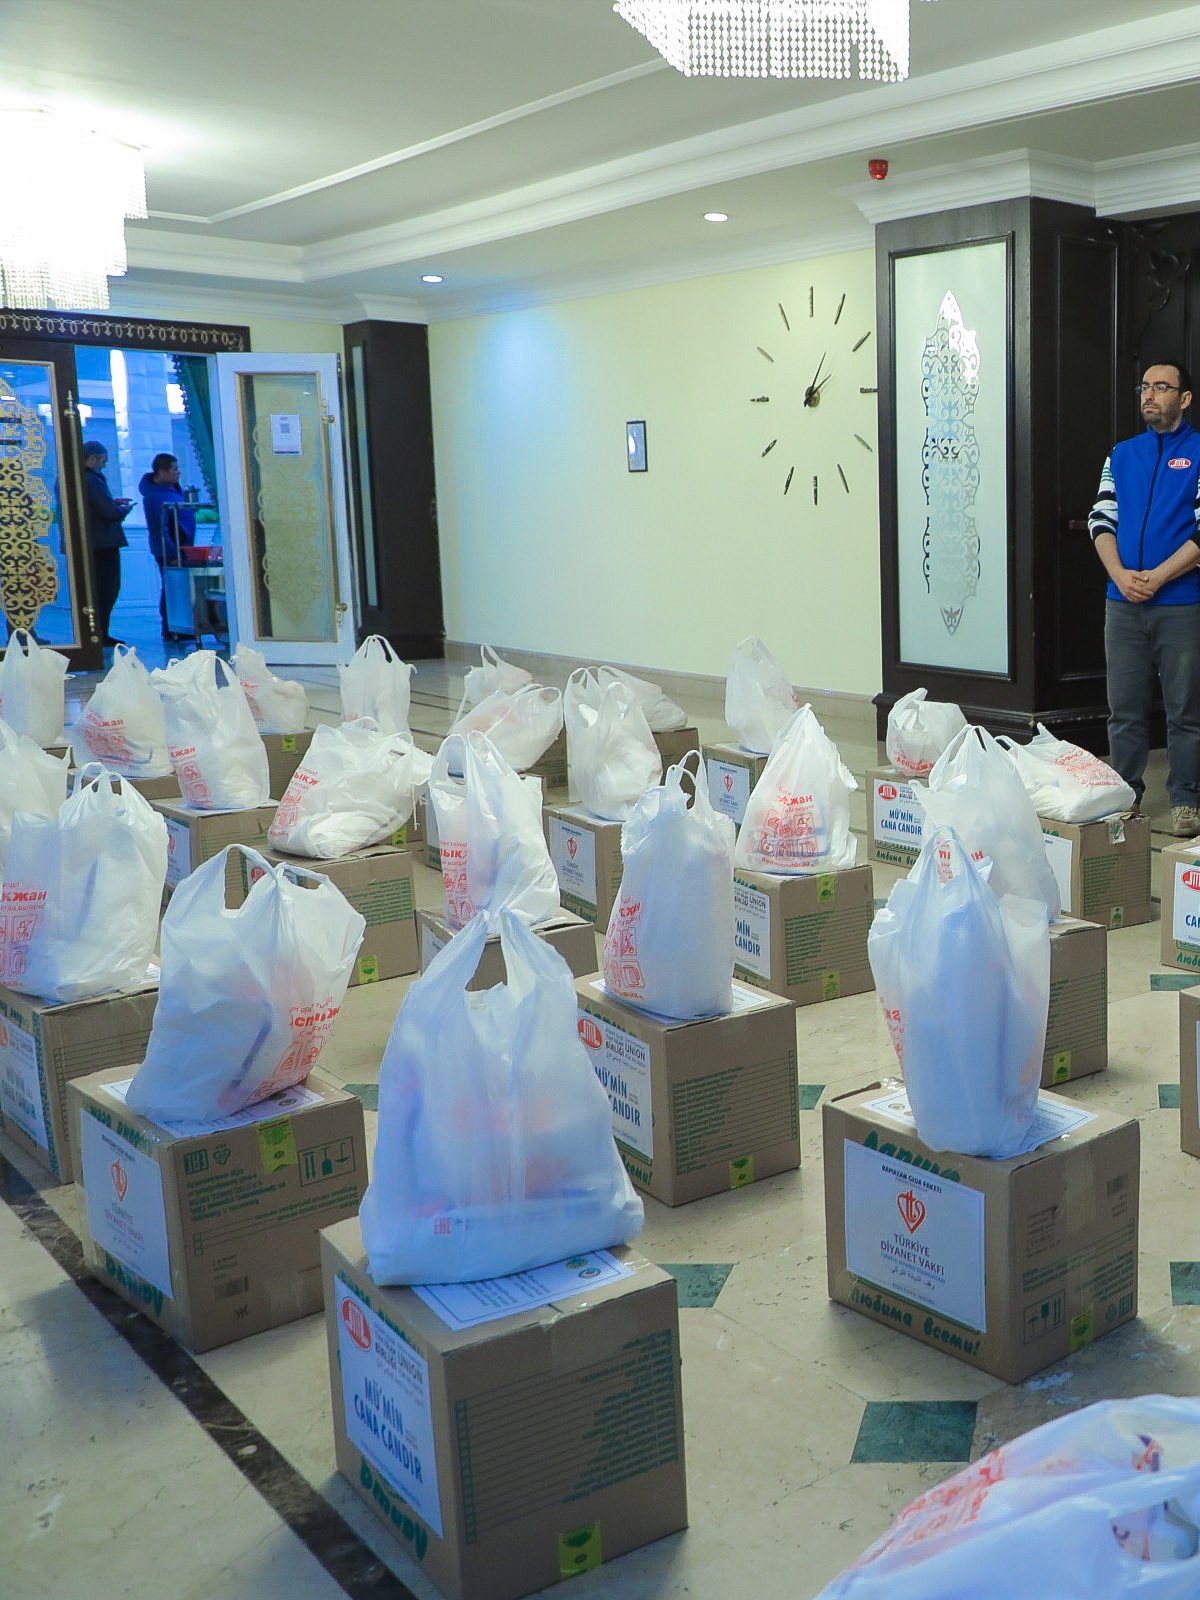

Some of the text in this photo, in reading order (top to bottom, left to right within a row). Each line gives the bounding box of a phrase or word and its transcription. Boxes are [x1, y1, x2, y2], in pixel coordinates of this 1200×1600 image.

[880, 819, 922, 835] CANA CANDIR
[612, 1096, 640, 1127] ANDIR
[880, 1239, 945, 1276] DİYANET VAKFI
[893, 1232, 930, 1258] TÜRKİYE
[851, 1286, 913, 1327] Любима
[923, 1316, 980, 1356] всеми!
[364, 1376, 404, 1437] MÜ'MİN
[354, 1393, 380, 1440] CANA
[381, 1423, 423, 1484] CANDIR
